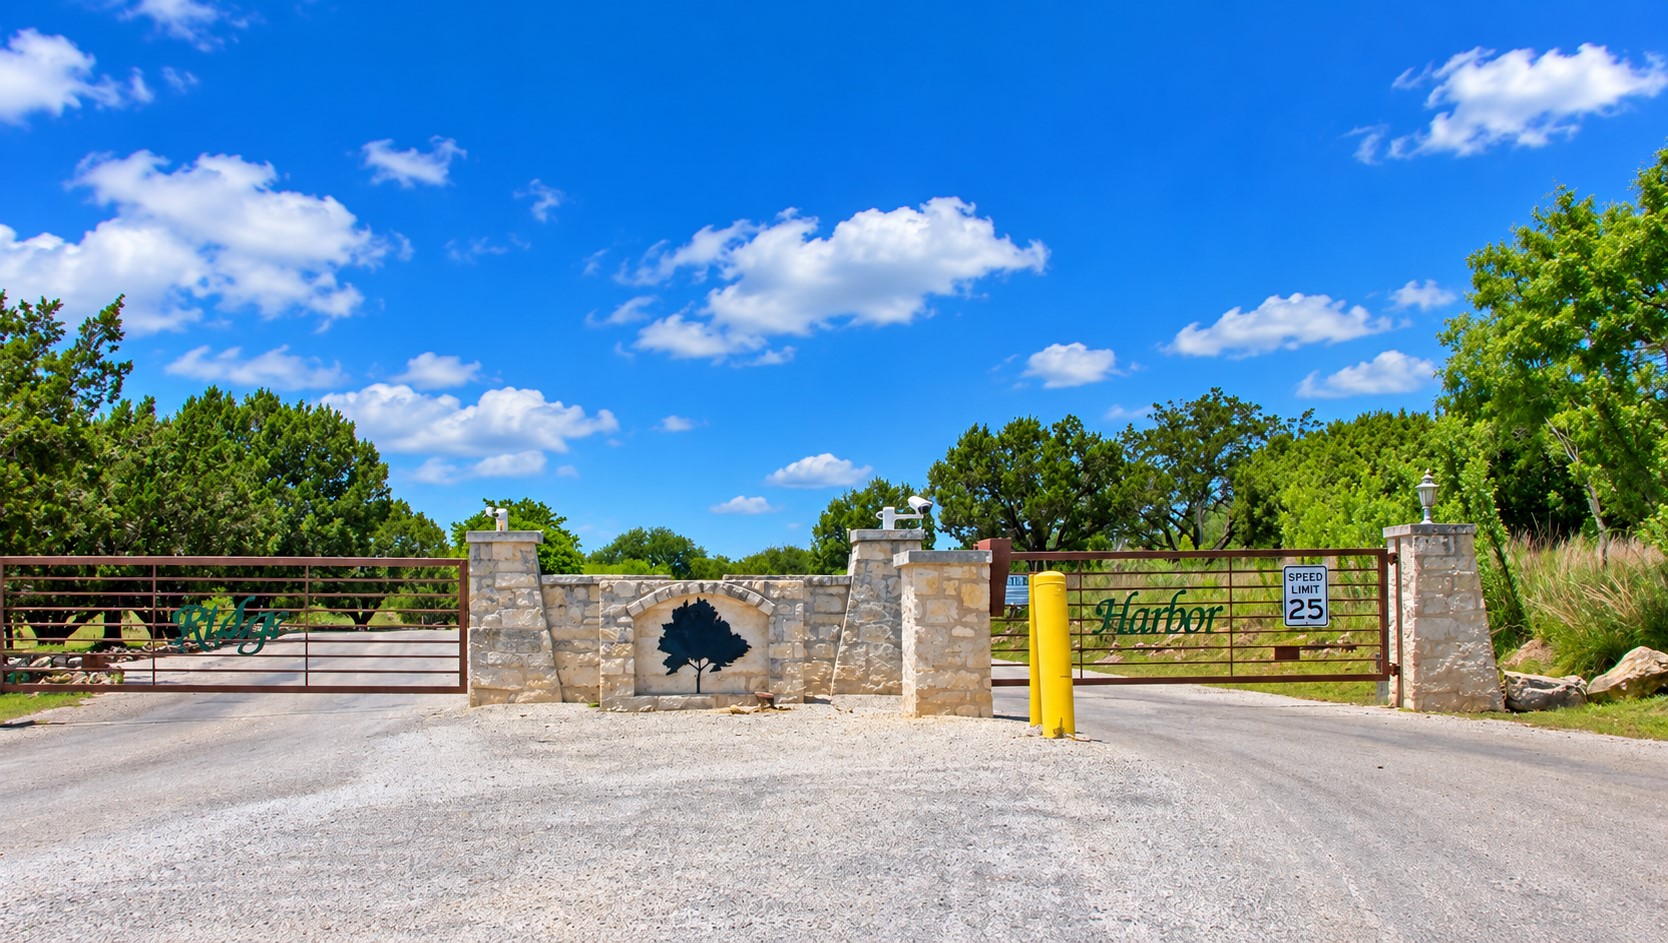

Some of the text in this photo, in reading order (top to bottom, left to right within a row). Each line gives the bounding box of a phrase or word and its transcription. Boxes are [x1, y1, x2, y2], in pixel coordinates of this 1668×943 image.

[1288, 572, 1323, 582] SPEED
[1291, 584, 1320, 594] LIMIT
[1092, 589, 1224, 635] Harbor
[1288, 598, 1324, 620] 25
